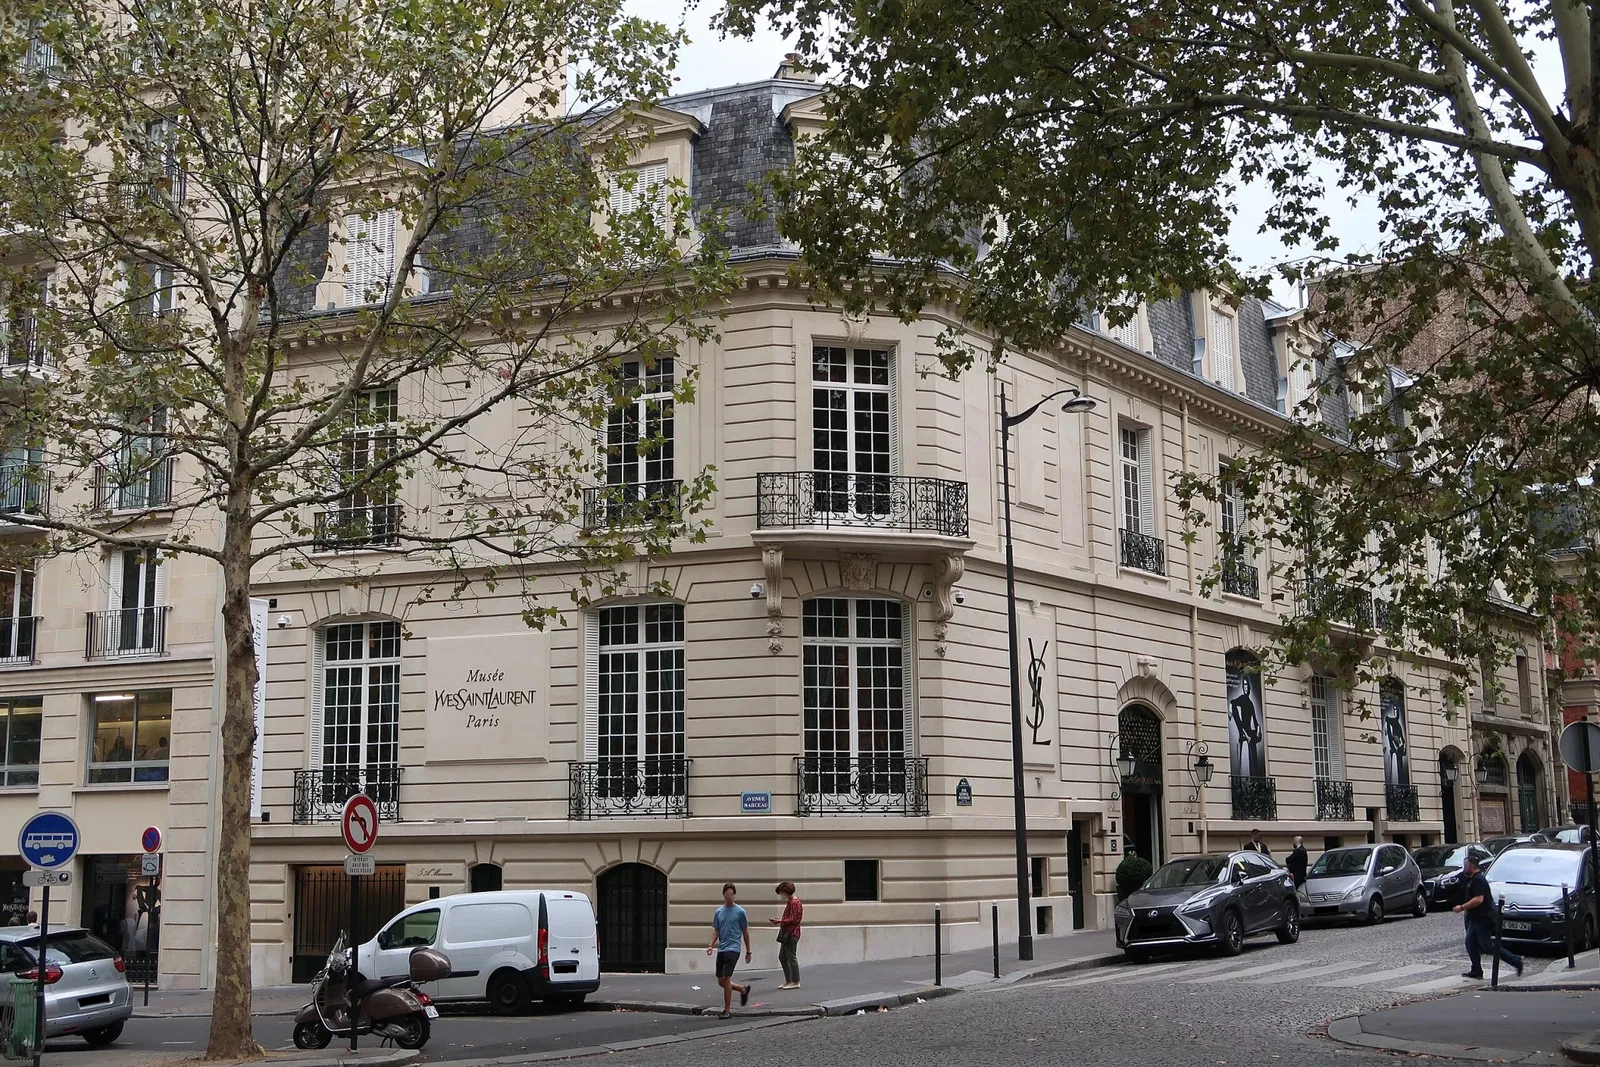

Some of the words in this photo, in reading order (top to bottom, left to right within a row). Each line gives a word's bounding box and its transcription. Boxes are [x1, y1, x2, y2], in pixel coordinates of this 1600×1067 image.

[466, 668, 505, 683] Musée
[1026, 637, 1051, 745] YSL
[466, 714, 500, 728] Paris
